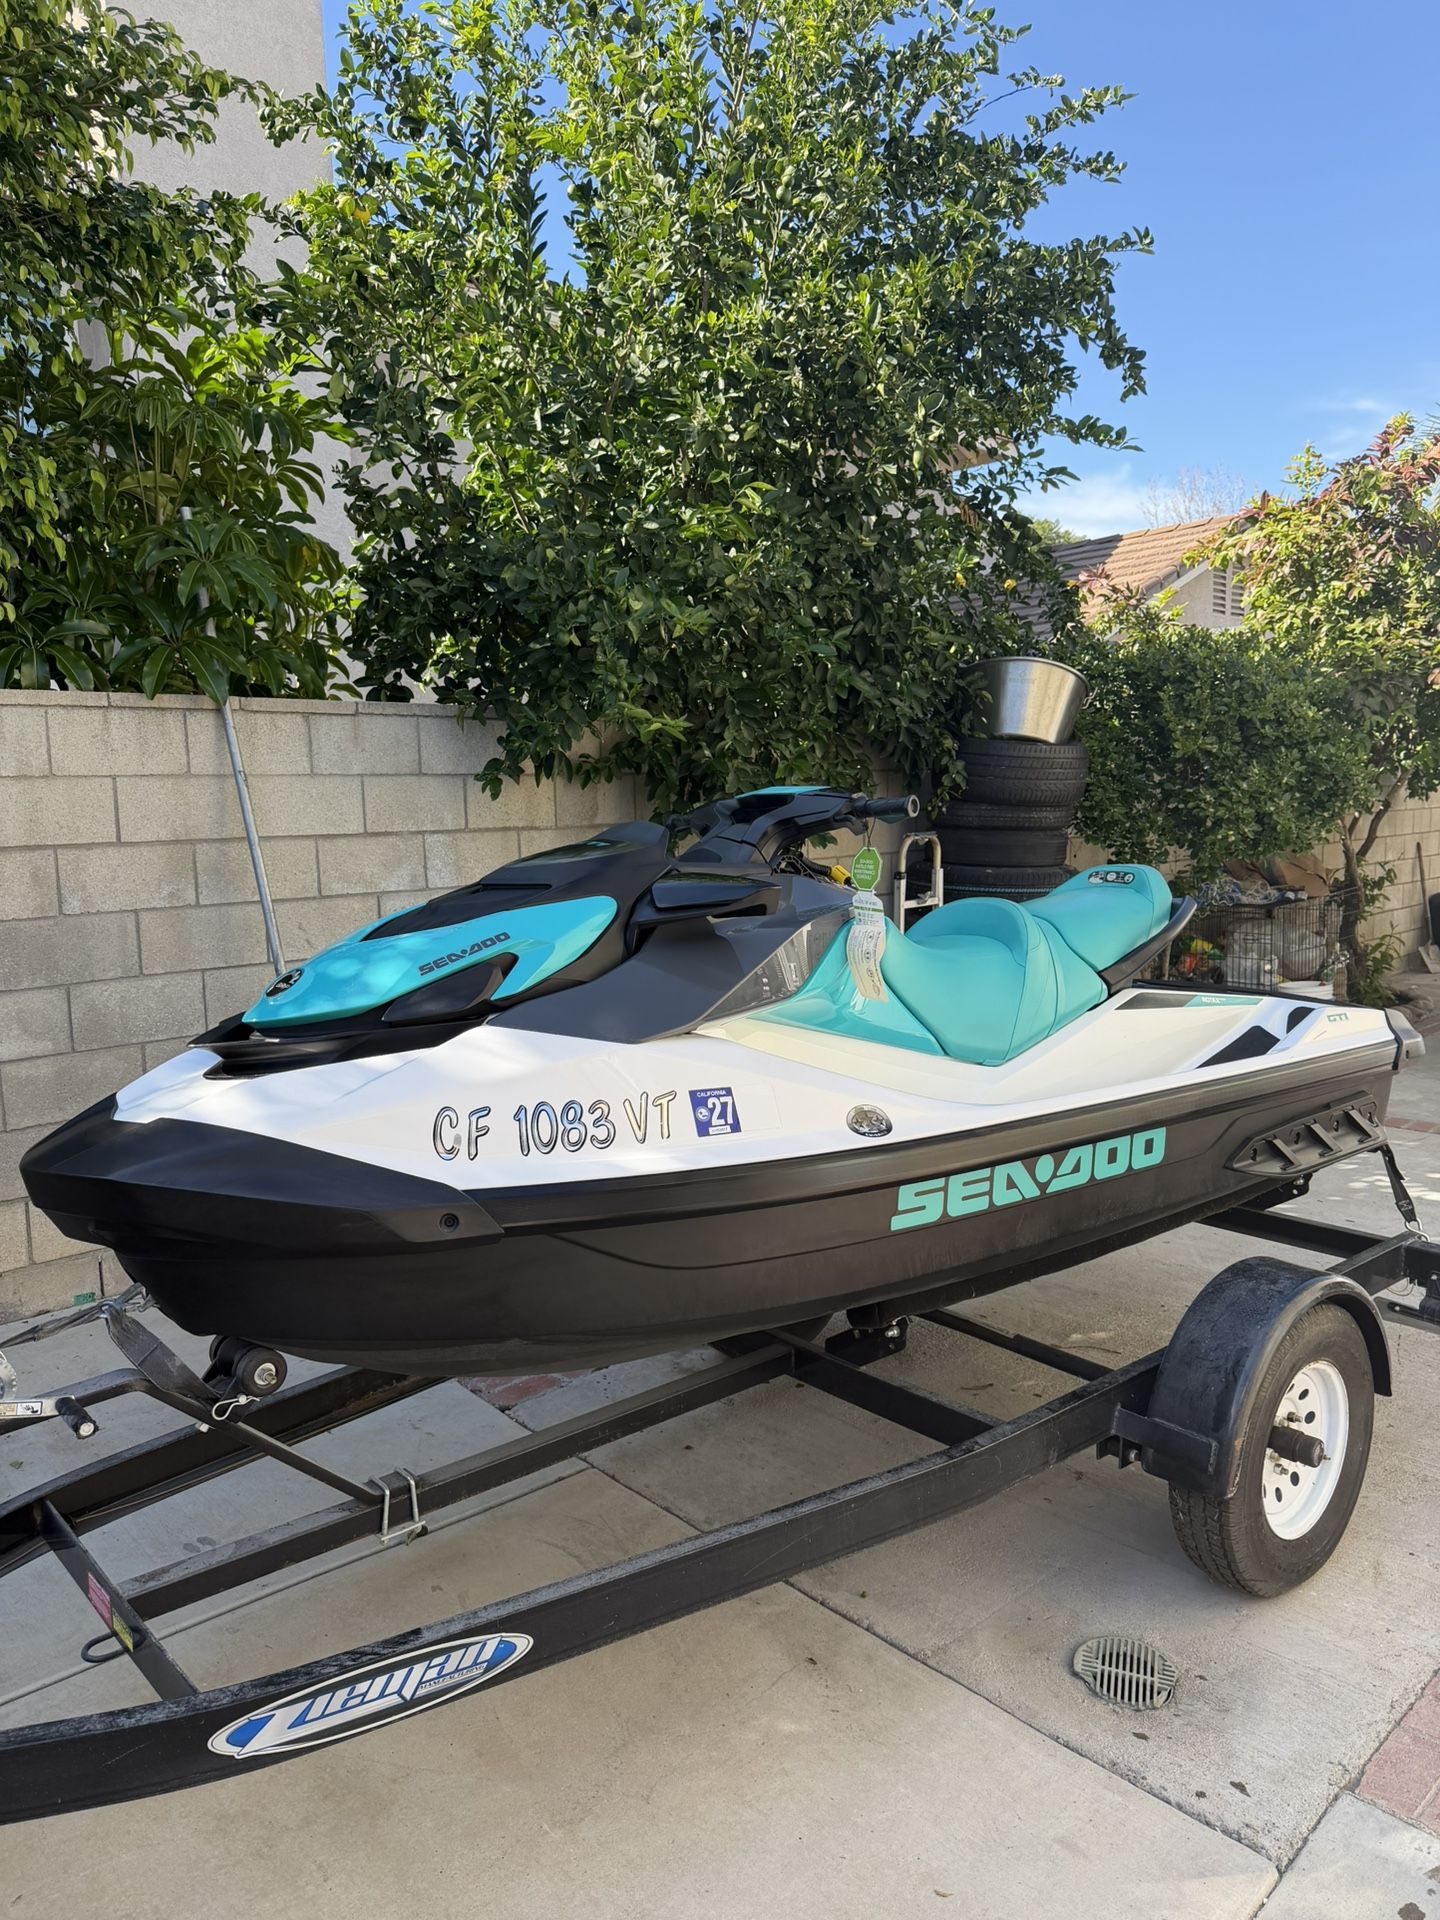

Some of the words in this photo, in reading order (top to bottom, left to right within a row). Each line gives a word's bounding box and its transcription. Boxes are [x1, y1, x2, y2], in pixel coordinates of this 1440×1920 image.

[697, 1090, 727, 1098] CALIFORNIA
[432, 1106, 491, 1161] CF
[513, 1099, 616, 1157] 1083
[623, 1090, 677, 1144] VT
[707, 1095, 733, 1126] 27
